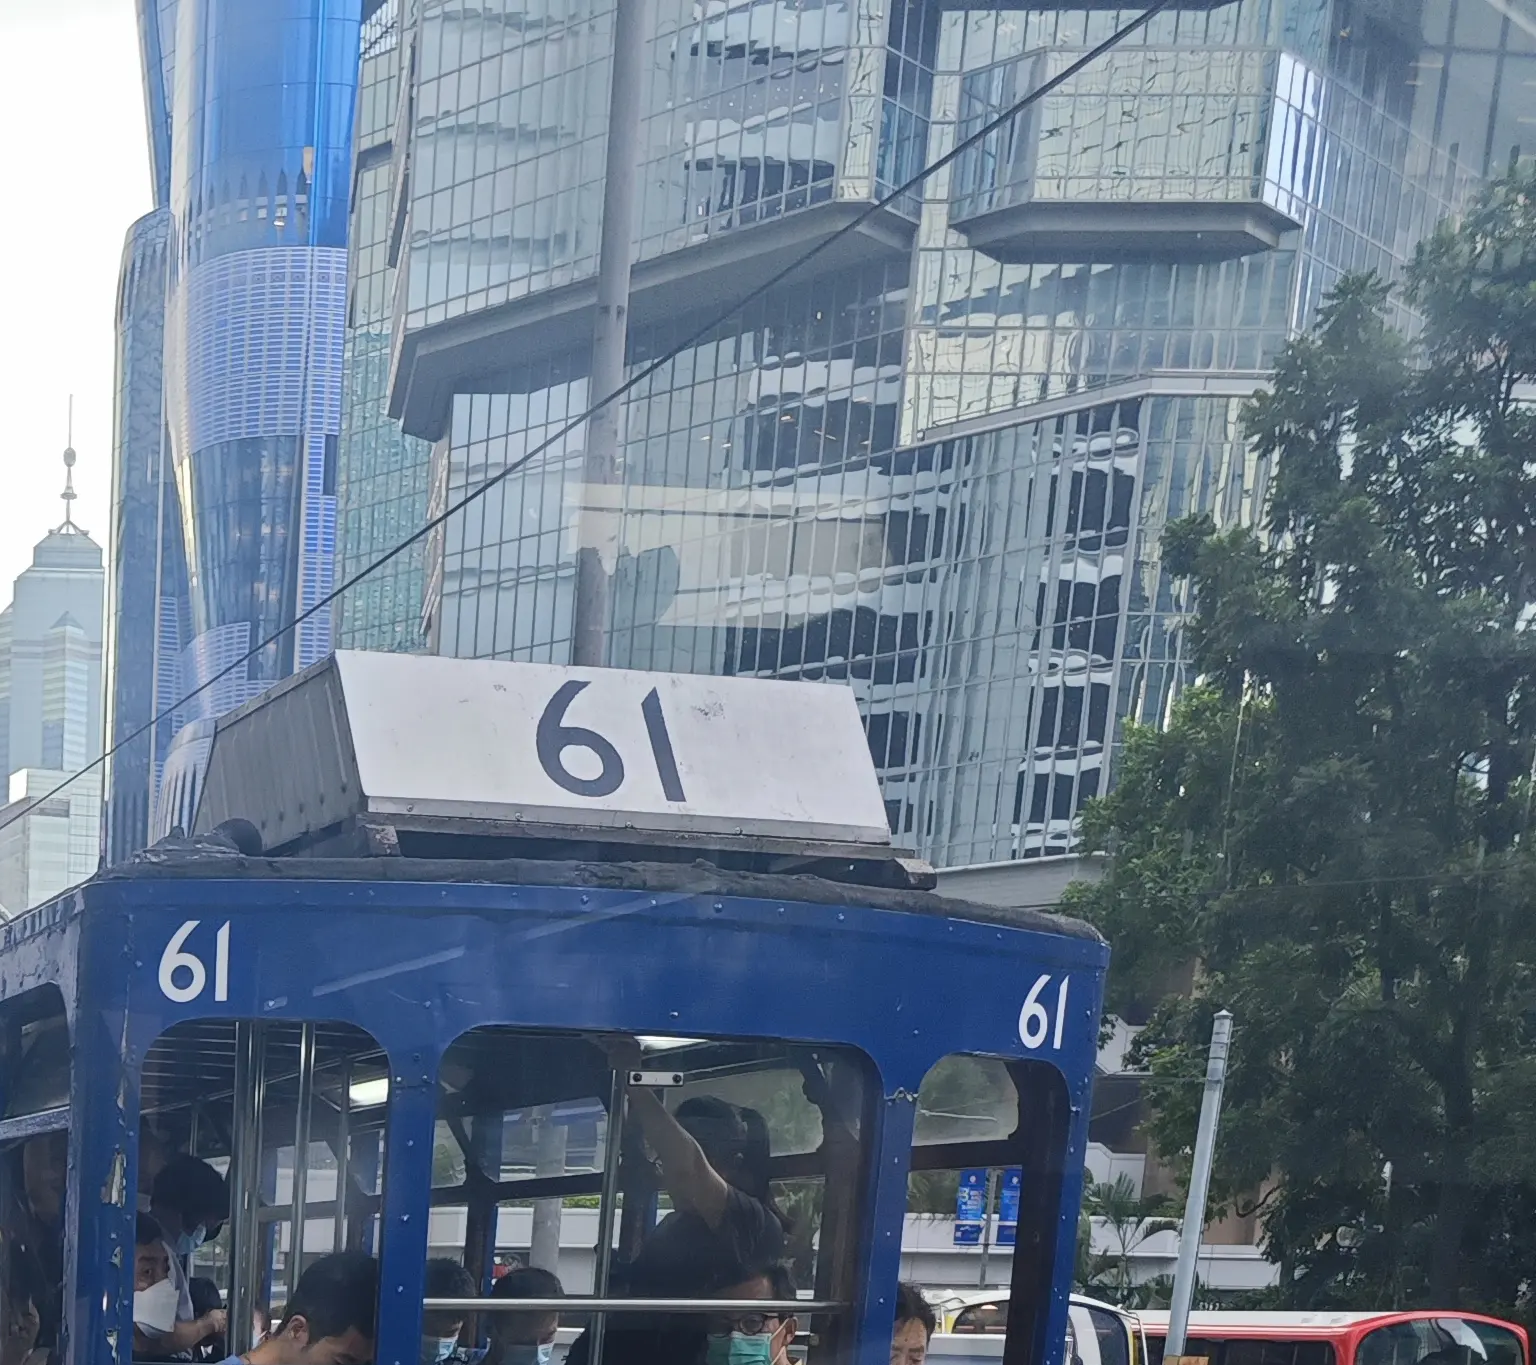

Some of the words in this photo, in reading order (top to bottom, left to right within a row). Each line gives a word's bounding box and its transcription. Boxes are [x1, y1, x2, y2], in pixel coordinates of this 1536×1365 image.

[536, 680, 687, 802] 61
[158, 919, 230, 1003] 61
[1018, 973, 1070, 1050] 61
